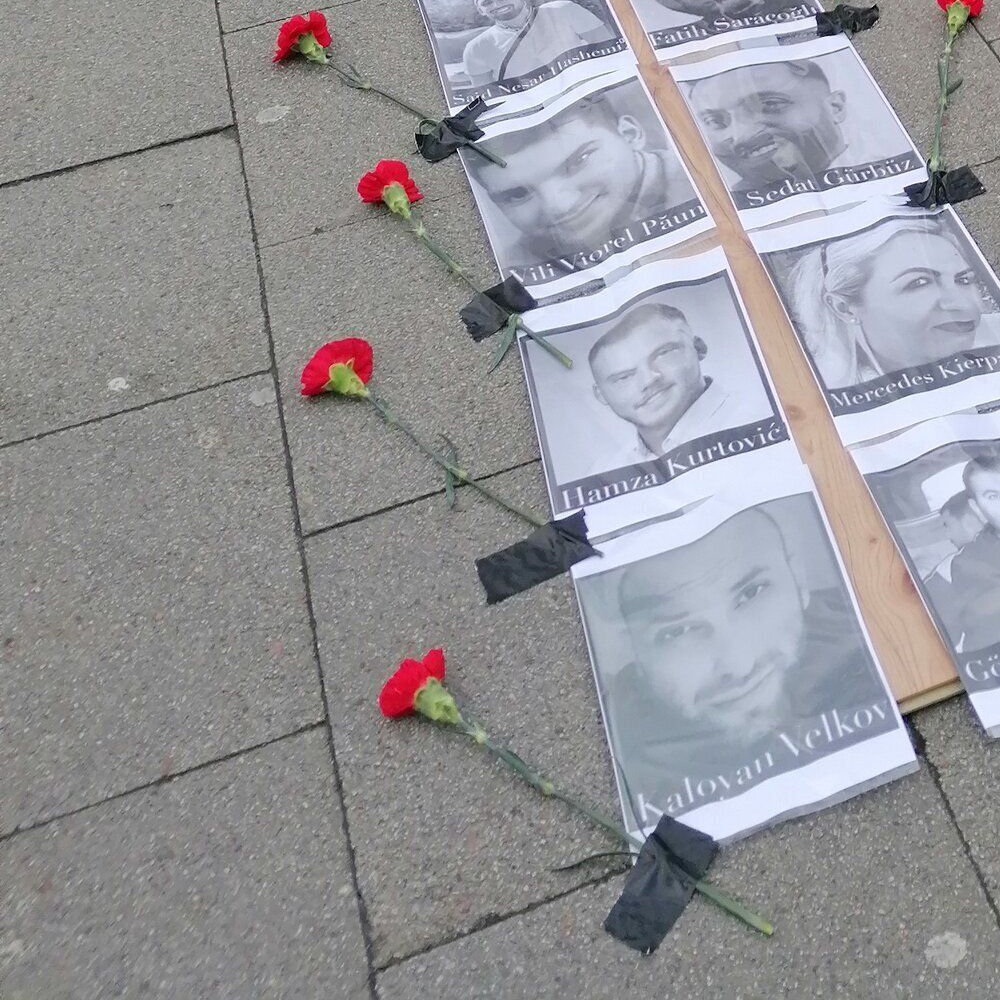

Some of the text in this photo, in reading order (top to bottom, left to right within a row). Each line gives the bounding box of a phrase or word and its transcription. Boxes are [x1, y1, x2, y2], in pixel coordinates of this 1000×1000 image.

[649, 24, 708, 46] Fatih
[452, 88, 492, 104] Said
[498, 74, 548, 95] Nesar
[746, 158, 915, 207] Sedat Gürbüz
[510, 203, 706, 283] Vili Viorel Păun
[830, 371, 934, 408] Mercedes
[561, 422, 782, 510] Hamza Kurtović
[637, 702, 888, 822] Kaloyan Velkov
